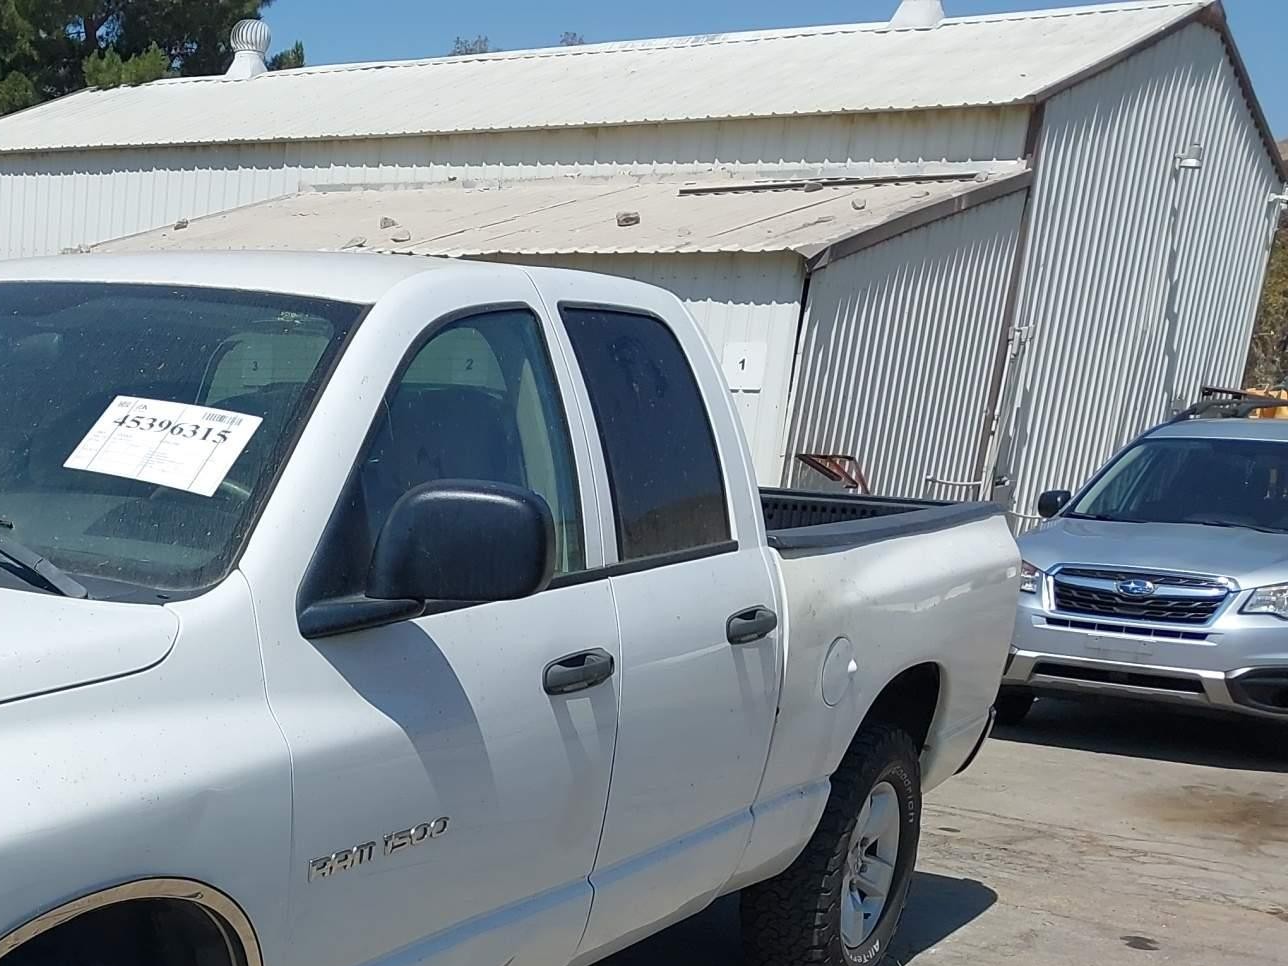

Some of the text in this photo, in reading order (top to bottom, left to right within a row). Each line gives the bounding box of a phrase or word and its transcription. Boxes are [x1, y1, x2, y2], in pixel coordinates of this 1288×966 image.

[465, 358, 475, 371] 2
[738, 357, 746, 371] 1
[113, 413, 233, 444] 45396315
[308, 816, 450, 882] RAM 1500
